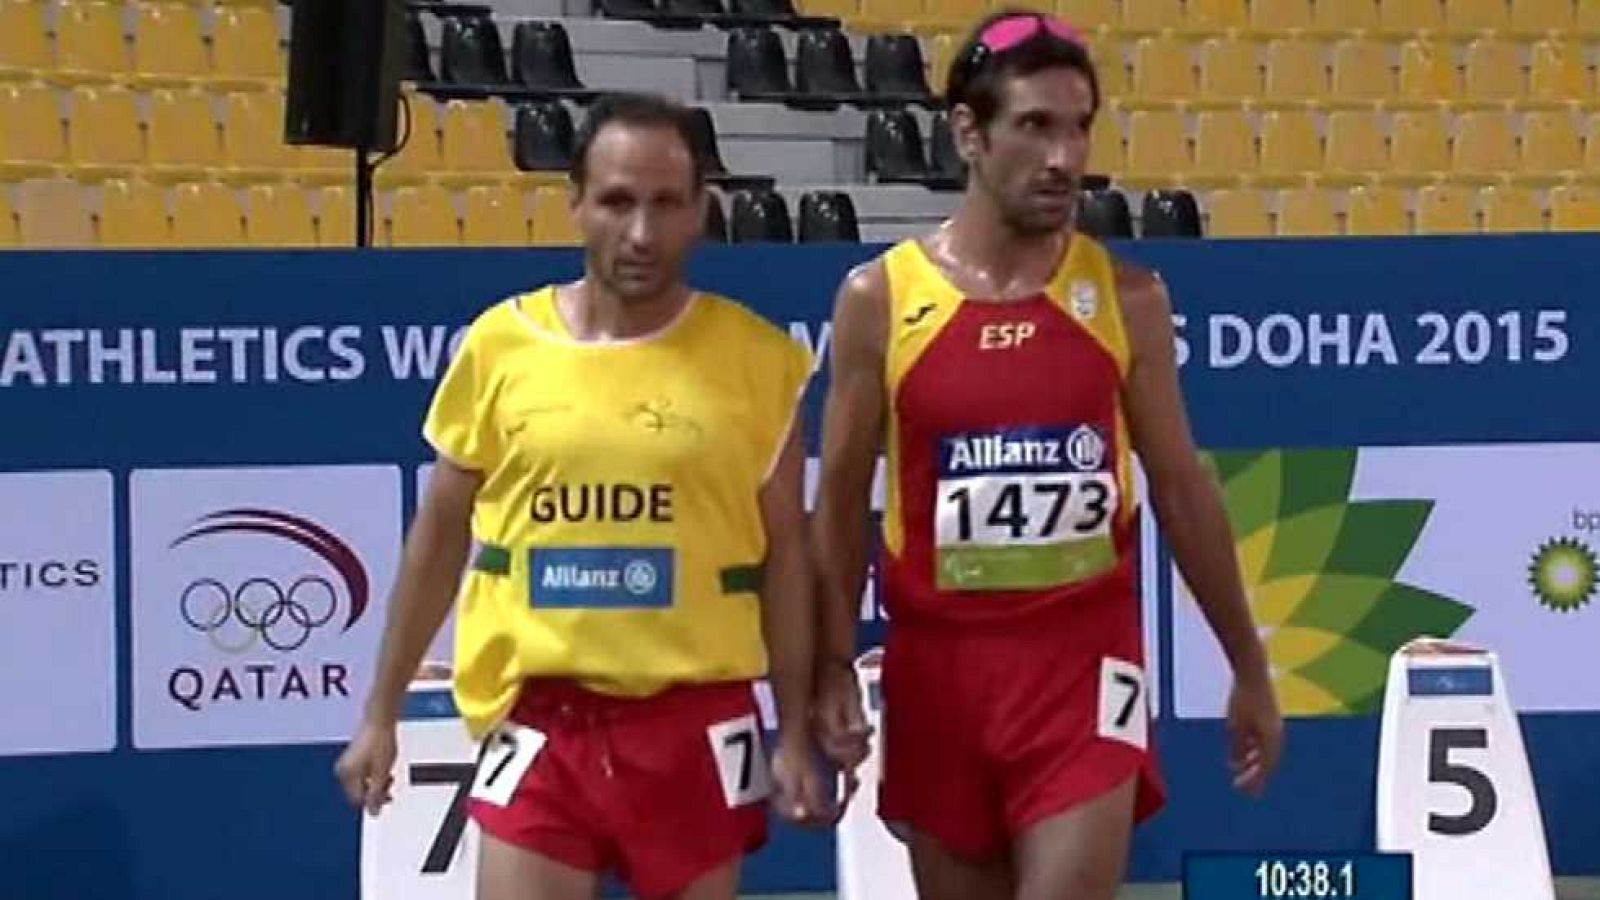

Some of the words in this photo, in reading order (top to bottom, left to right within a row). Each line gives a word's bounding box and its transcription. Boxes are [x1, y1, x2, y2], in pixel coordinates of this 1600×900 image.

[0, 326, 366, 386] ATHLETICS
[1208, 312, 1399, 368] DOHA
[1415, 310, 1569, 364] 2015
[979, 321, 1036, 350] ESP
[949, 434, 1061, 470] Allianz
[530, 483, 674, 523] GUIDE
[946, 480, 1111, 541] 1473
[1573, 503, 1600, 534] bp
[541, 564, 620, 590] Allianz
[168, 663, 349, 711] QATAR
[1113, 672, 1140, 727] 7
[482, 732, 519, 787] 7
[723, 731, 754, 791] 7
[1427, 728, 1499, 836] 5
[408, 762, 477, 874] 7
